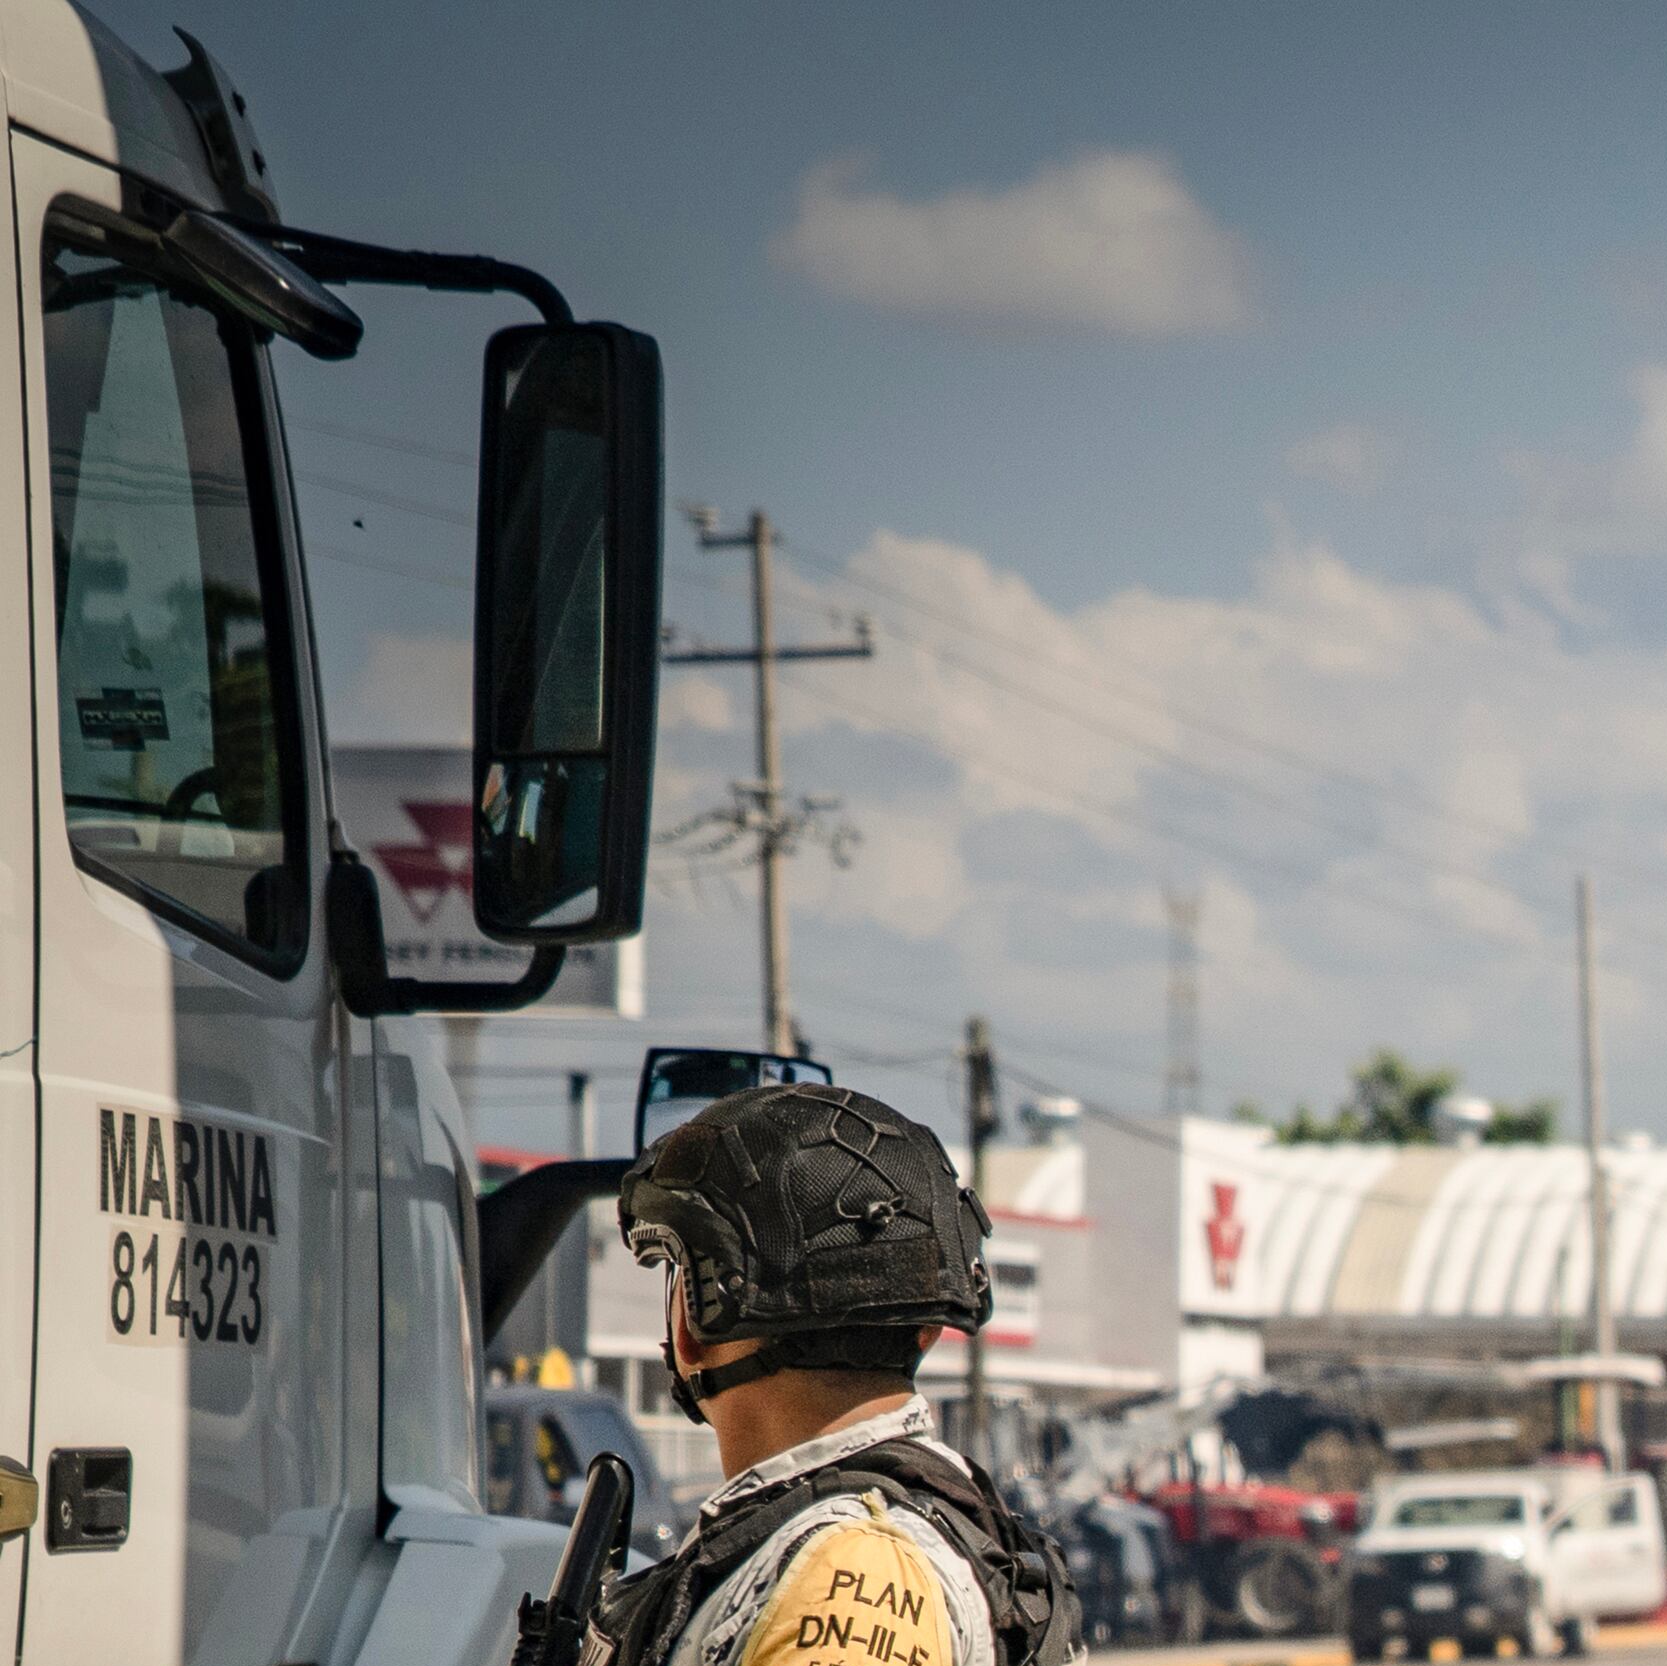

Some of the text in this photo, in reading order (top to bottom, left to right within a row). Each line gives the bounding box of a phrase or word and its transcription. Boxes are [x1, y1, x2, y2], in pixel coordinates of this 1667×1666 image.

[100, 1109, 276, 1236] MARINA
[111, 1231, 262, 1344] 814323
[826, 1569, 924, 1626] PLAN
